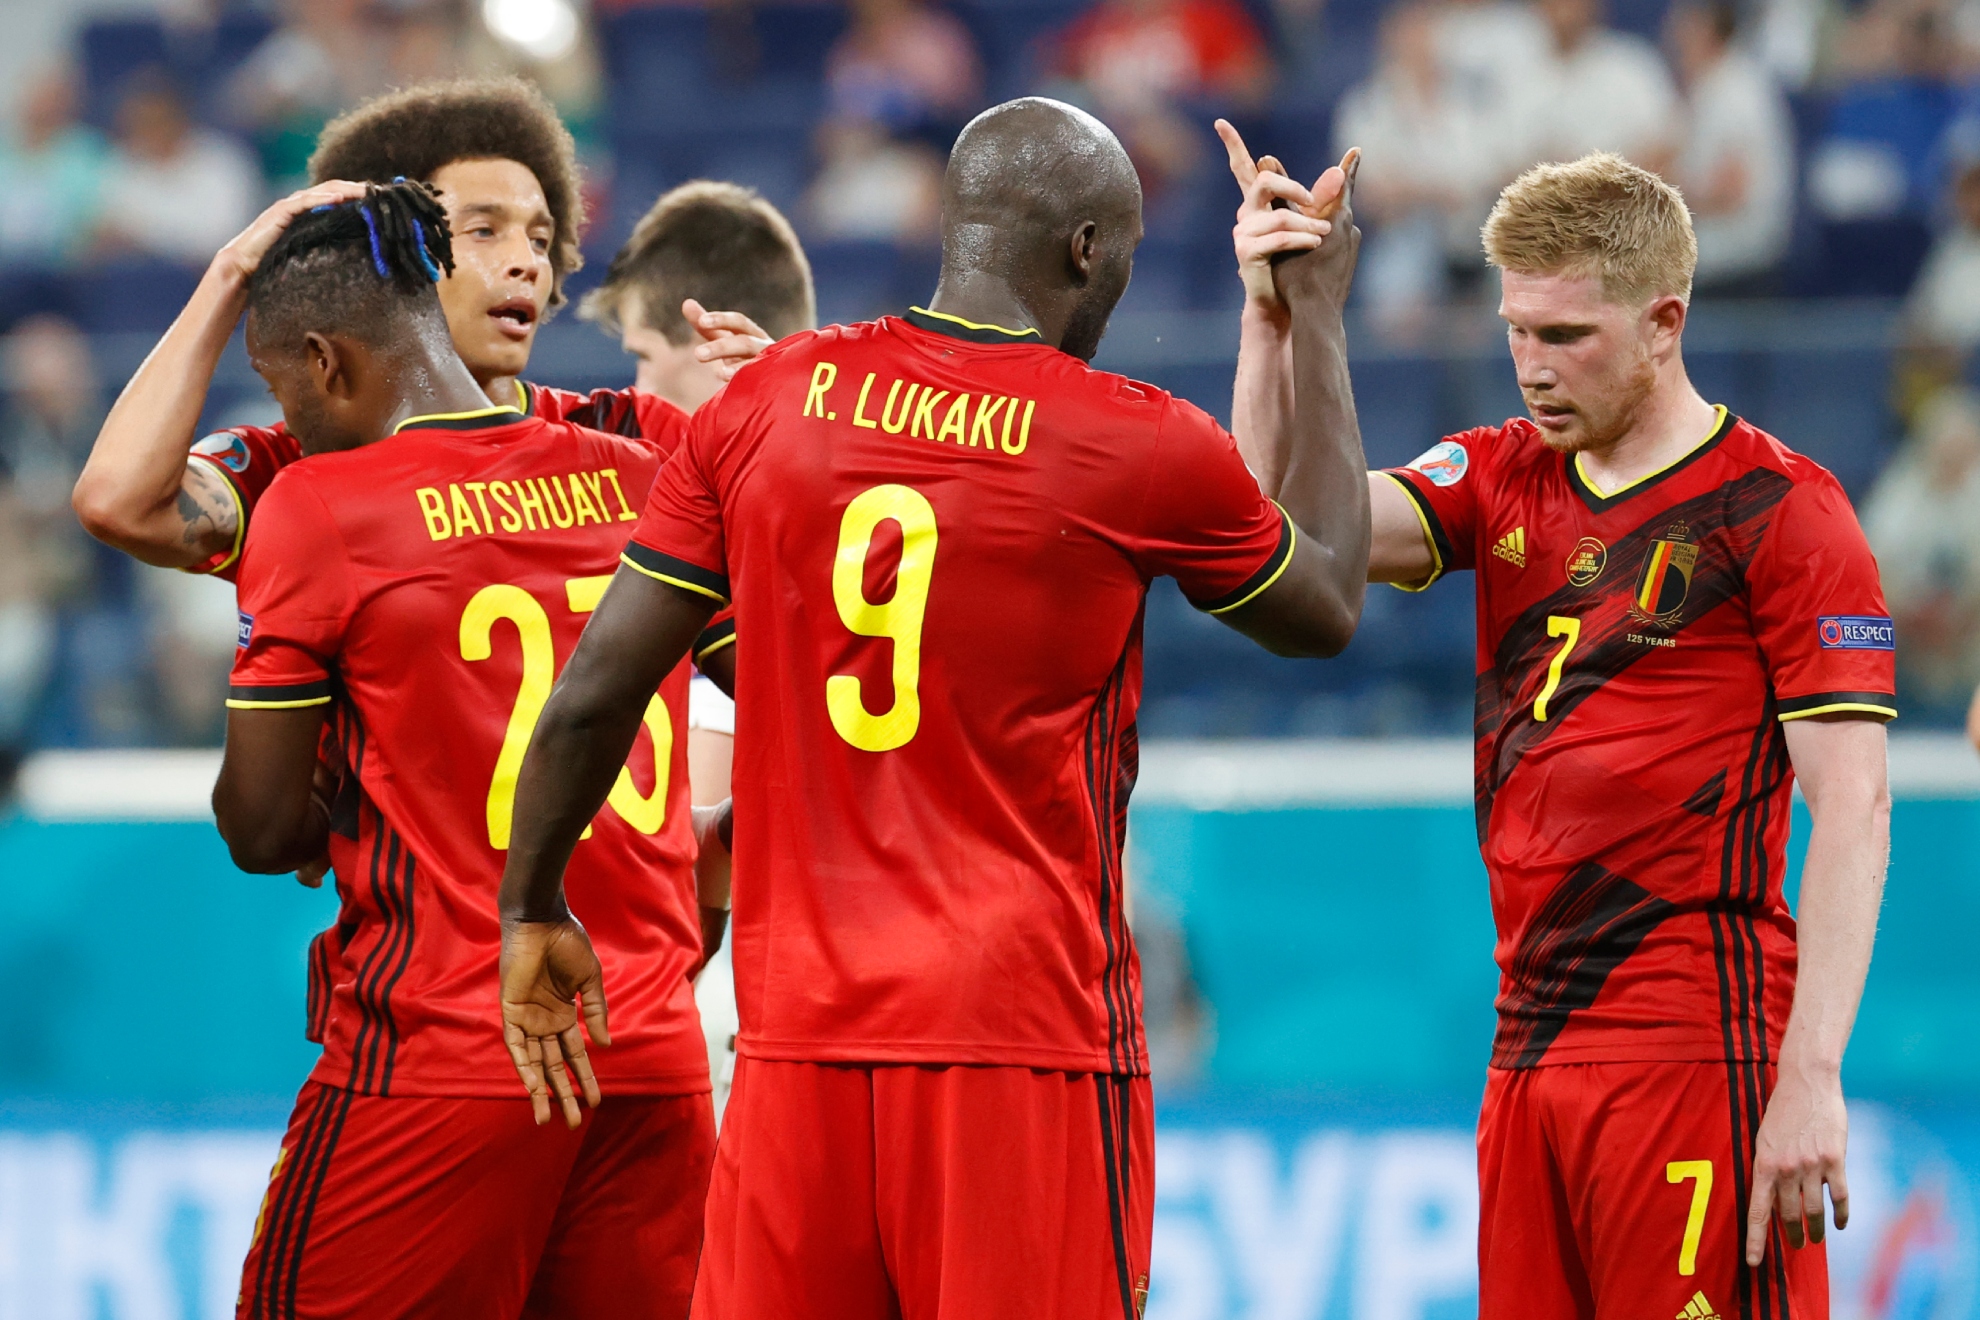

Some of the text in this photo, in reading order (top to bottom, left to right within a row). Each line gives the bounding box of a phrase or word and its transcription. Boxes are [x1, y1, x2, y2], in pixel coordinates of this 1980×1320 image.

[803, 361, 1036, 456] R. LUKAKU
[415, 468, 638, 542] BATSHUAYI
[1492, 544, 1526, 569] adidas
[826, 483, 939, 752] 9
[1627, 633, 1676, 648] 125 YEARS
[1843, 625, 1893, 642] RESPECT
[1533, 615, 1581, 722] 7
[1666, 1159, 1714, 1276] 7
